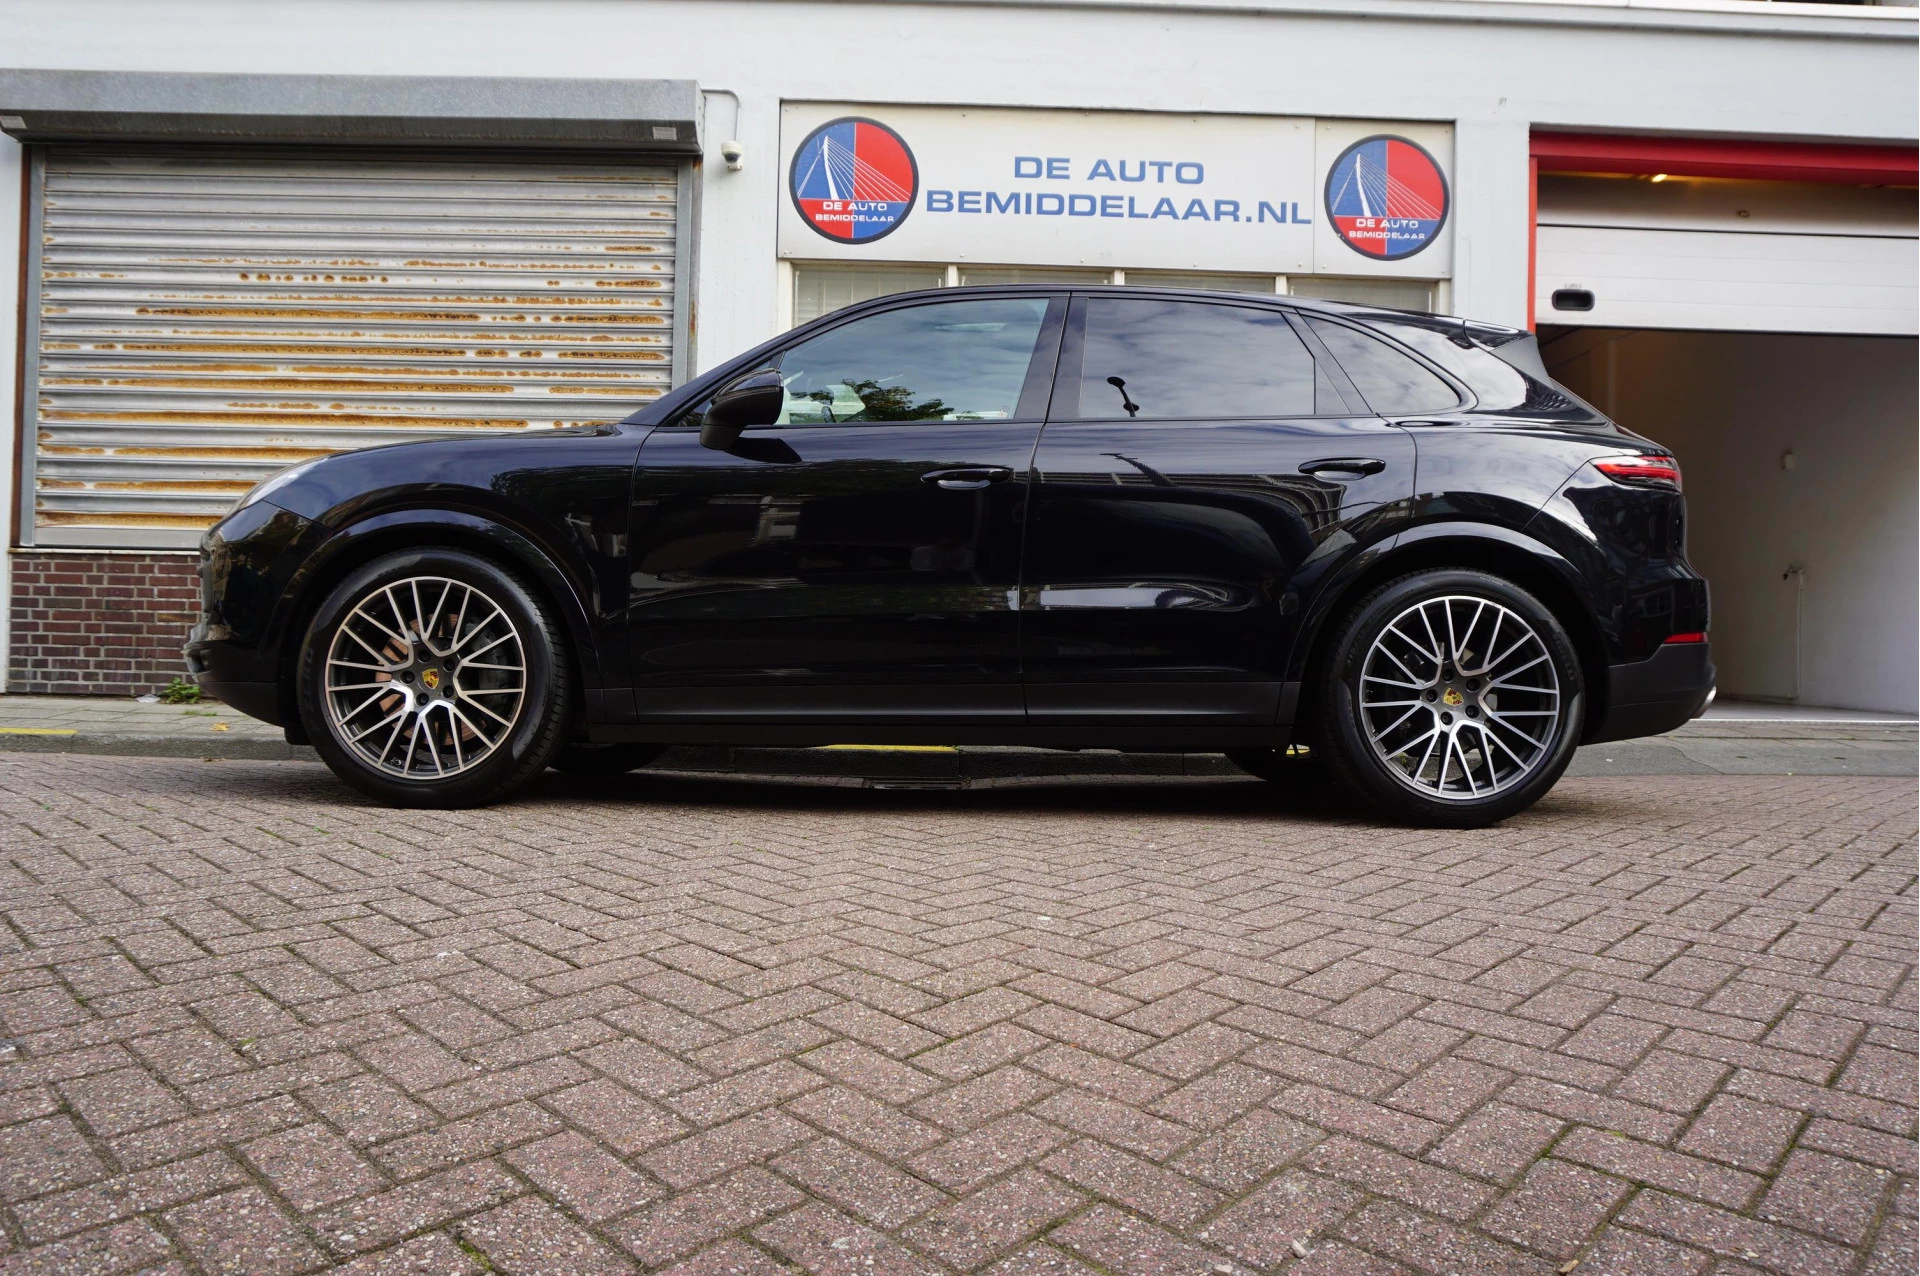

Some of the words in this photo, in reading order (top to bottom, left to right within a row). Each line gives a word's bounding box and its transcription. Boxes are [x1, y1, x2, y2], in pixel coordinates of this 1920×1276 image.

[1013, 156, 1071, 180] DE
[1086, 158, 1205, 185] AUTO
[822, 201, 843, 211] DE
[847, 202, 888, 212] AUTO
[926, 189, 1312, 225] BEMIDDELAAR.NL
[815, 213, 894, 223] BEMIDDELAAR
[1356, 218, 1376, 228] DE
[1380, 219, 1419, 229] AUTO
[1348, 230, 1426, 240] BEMIDDELAAR
